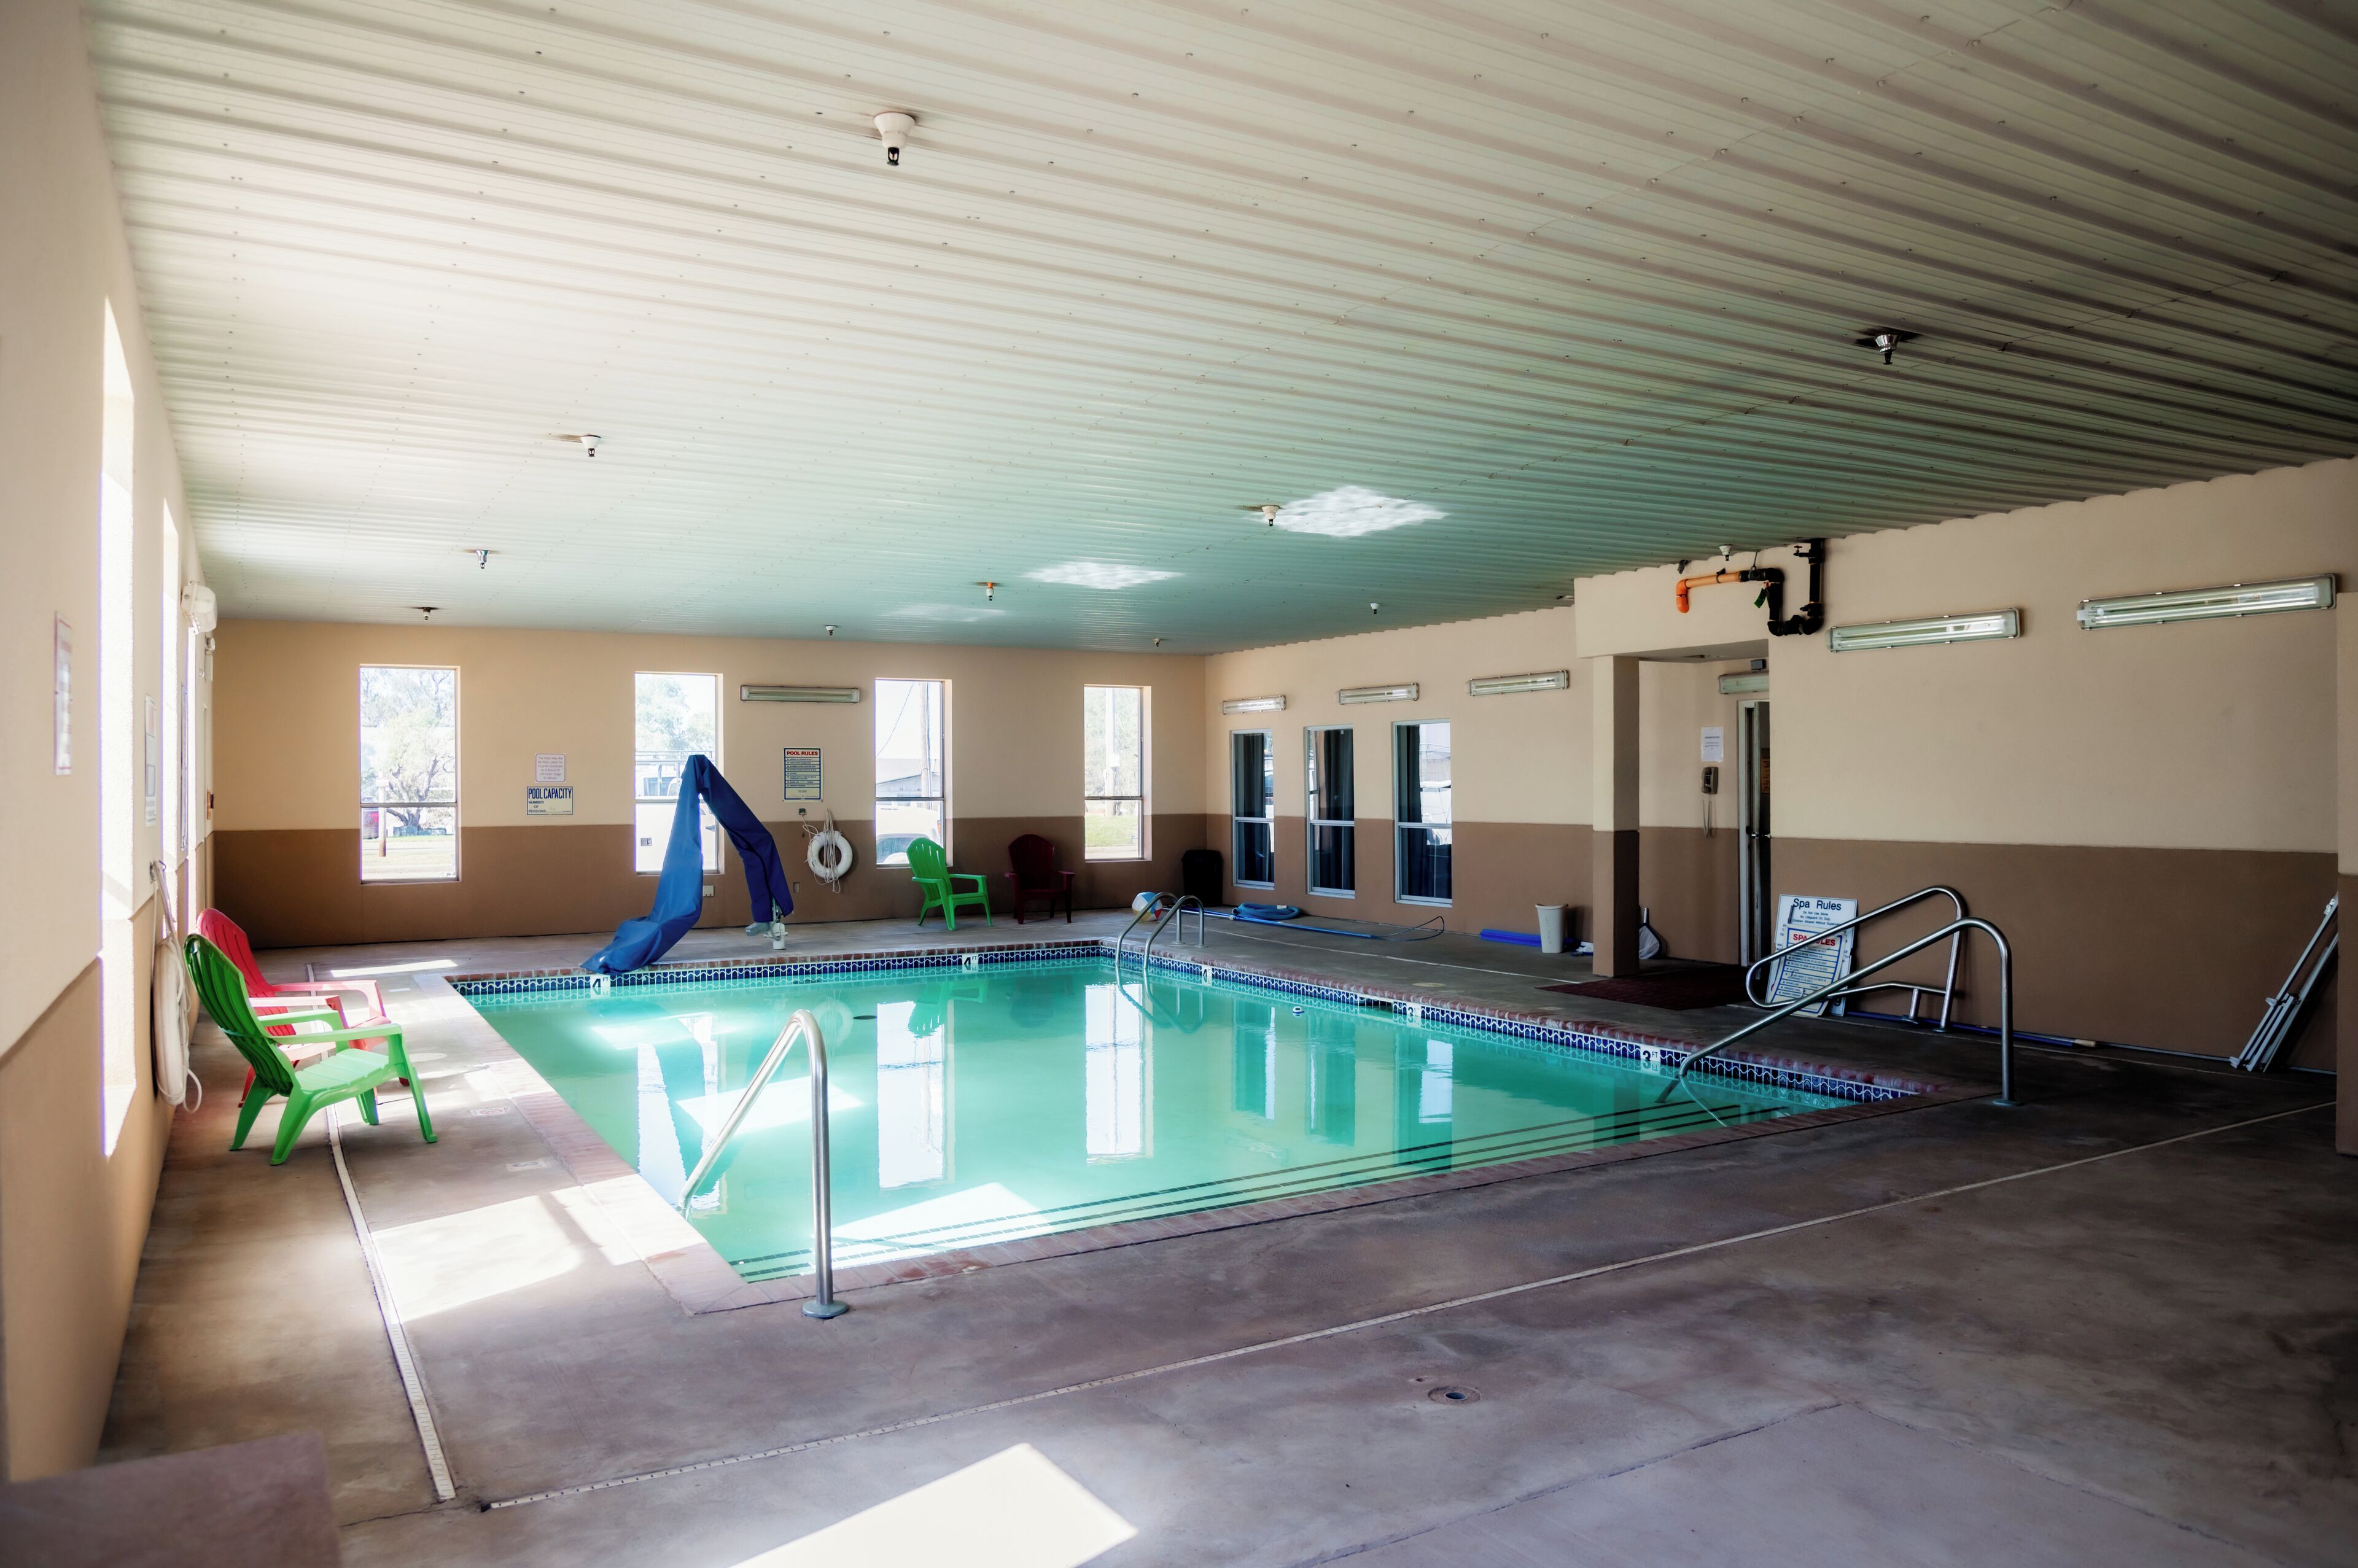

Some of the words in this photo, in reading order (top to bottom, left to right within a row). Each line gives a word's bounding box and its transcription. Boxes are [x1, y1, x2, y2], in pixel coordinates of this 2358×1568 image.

[529, 788, 543, 799] POOL
[543, 788, 572, 799] CAPACITY
[1793, 898, 1810, 909] Spa
[1816, 900, 1842, 910] Rules
[1815, 937, 1835, 946] LES
[592, 978, 601, 987] 4
[1643, 1050, 1651, 1061] 3
